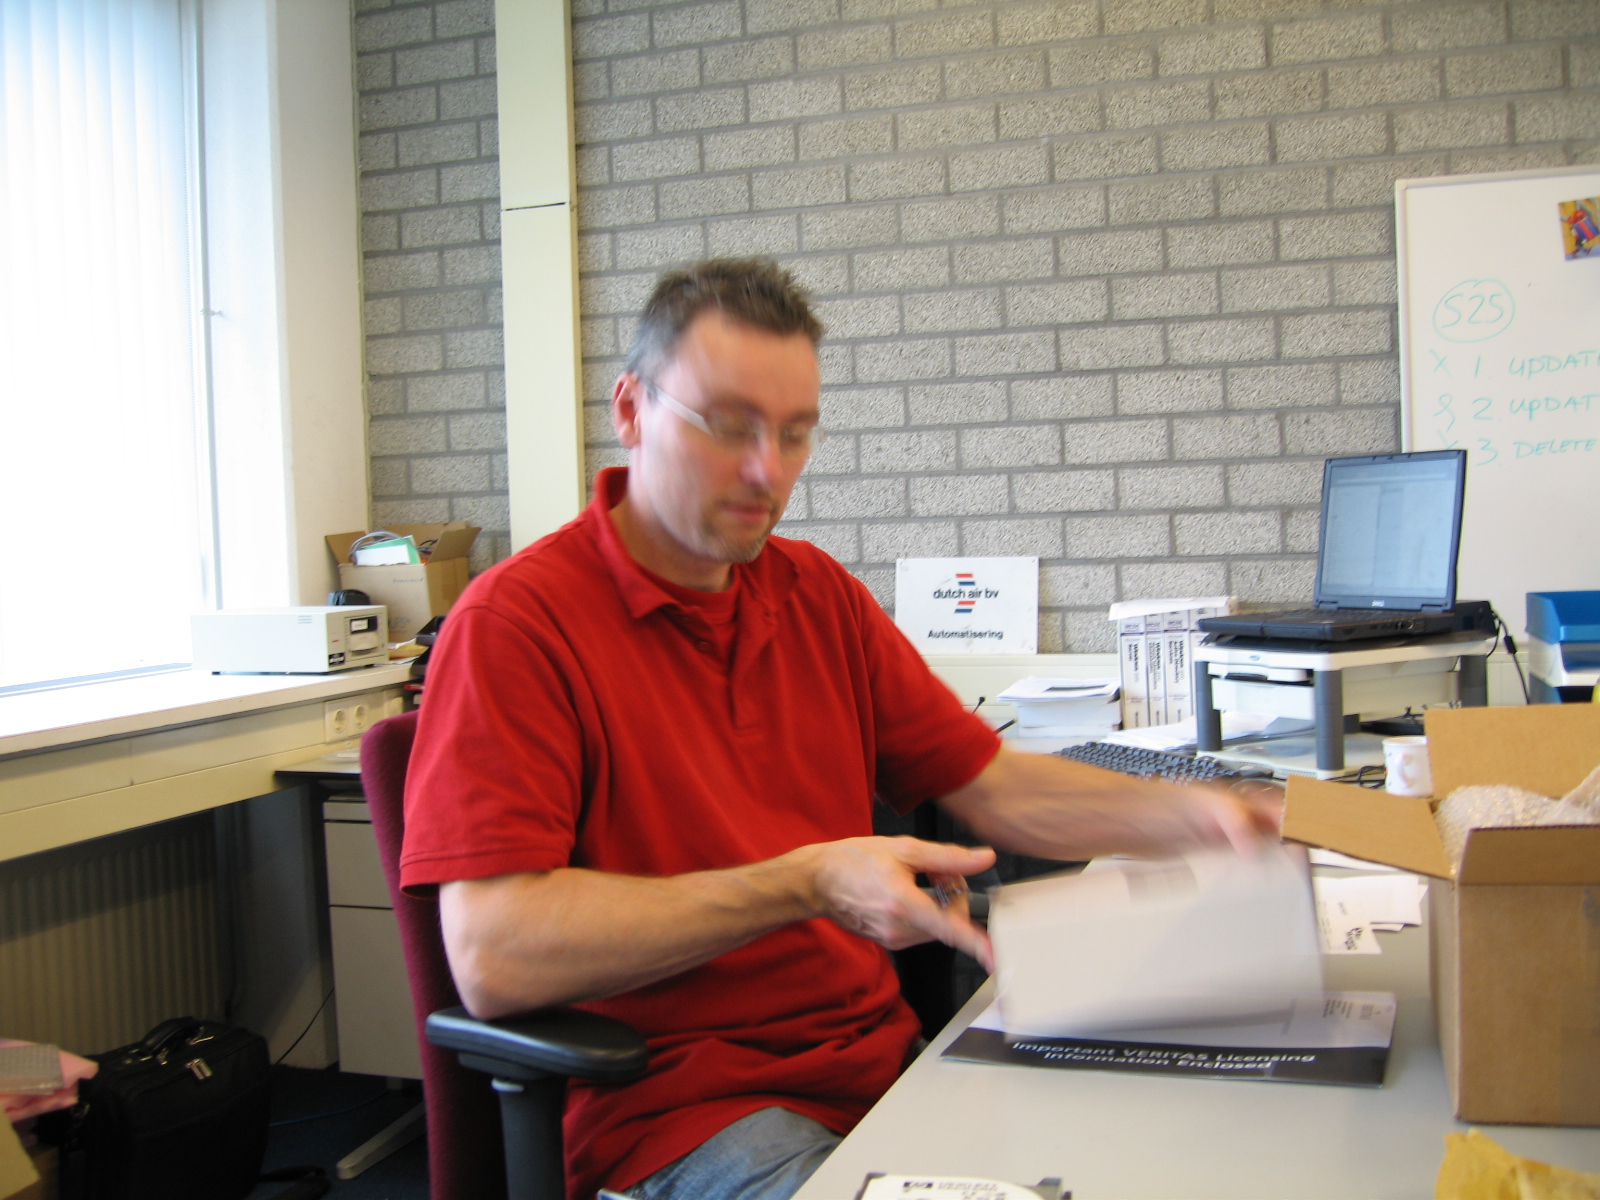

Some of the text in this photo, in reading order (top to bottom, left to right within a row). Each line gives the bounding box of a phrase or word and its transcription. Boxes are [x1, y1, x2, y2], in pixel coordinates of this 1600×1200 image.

[1508, 350, 1600, 380] UPDAT
[1513, 438, 1598, 460] DELETE
[933, 588, 999, 599] dutch air bv
[927, 629, 1004, 640] Automatisering
[1012, 1041, 1316, 1063] Important VERITAS Licensing
[1043, 1051, 1273, 1070] Information Enclosed
